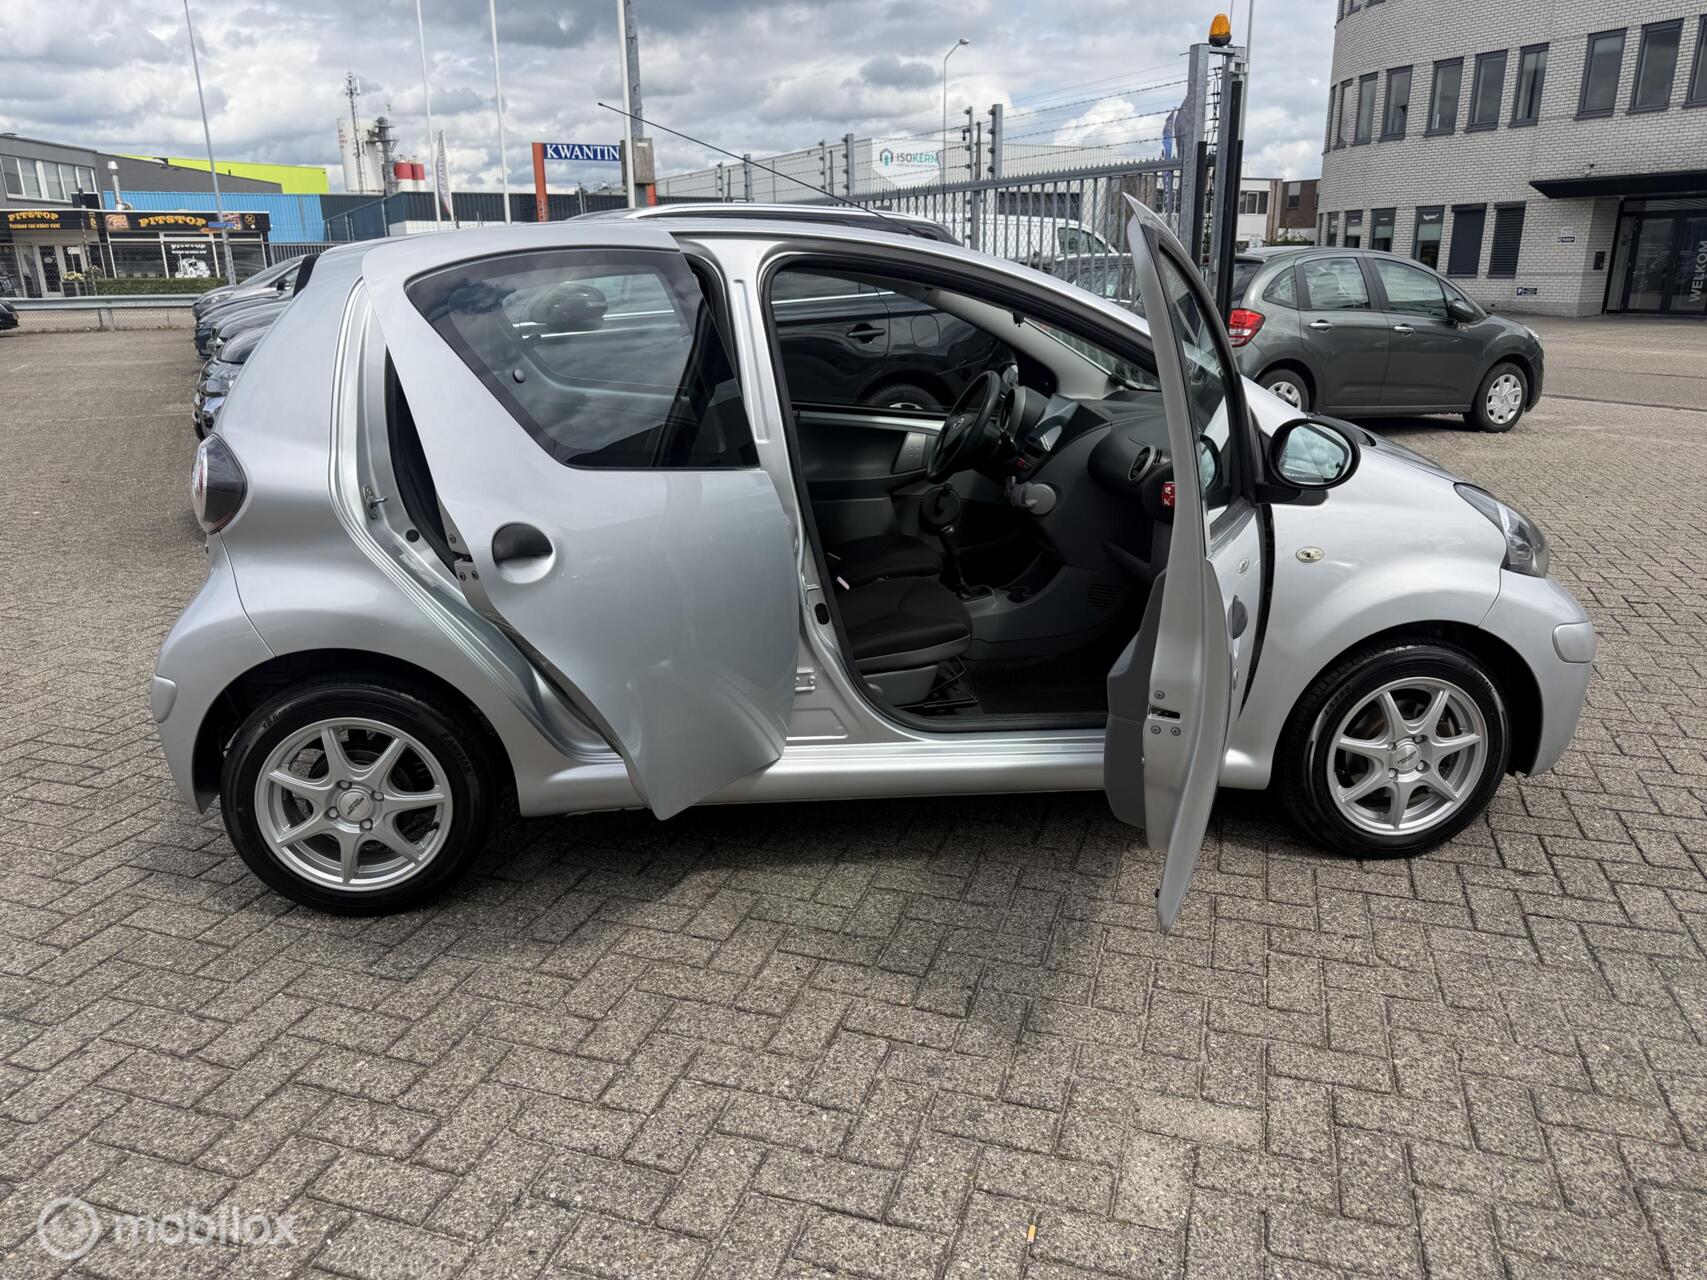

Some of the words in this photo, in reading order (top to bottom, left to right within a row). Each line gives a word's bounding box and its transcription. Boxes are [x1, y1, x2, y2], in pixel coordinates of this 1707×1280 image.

[896, 152, 937, 164] ISOKERN
[8, 211, 59, 221] PITSTOP
[138, 215, 207, 228] PITSTOP
[1688, 240, 1707, 302] WELKOM
